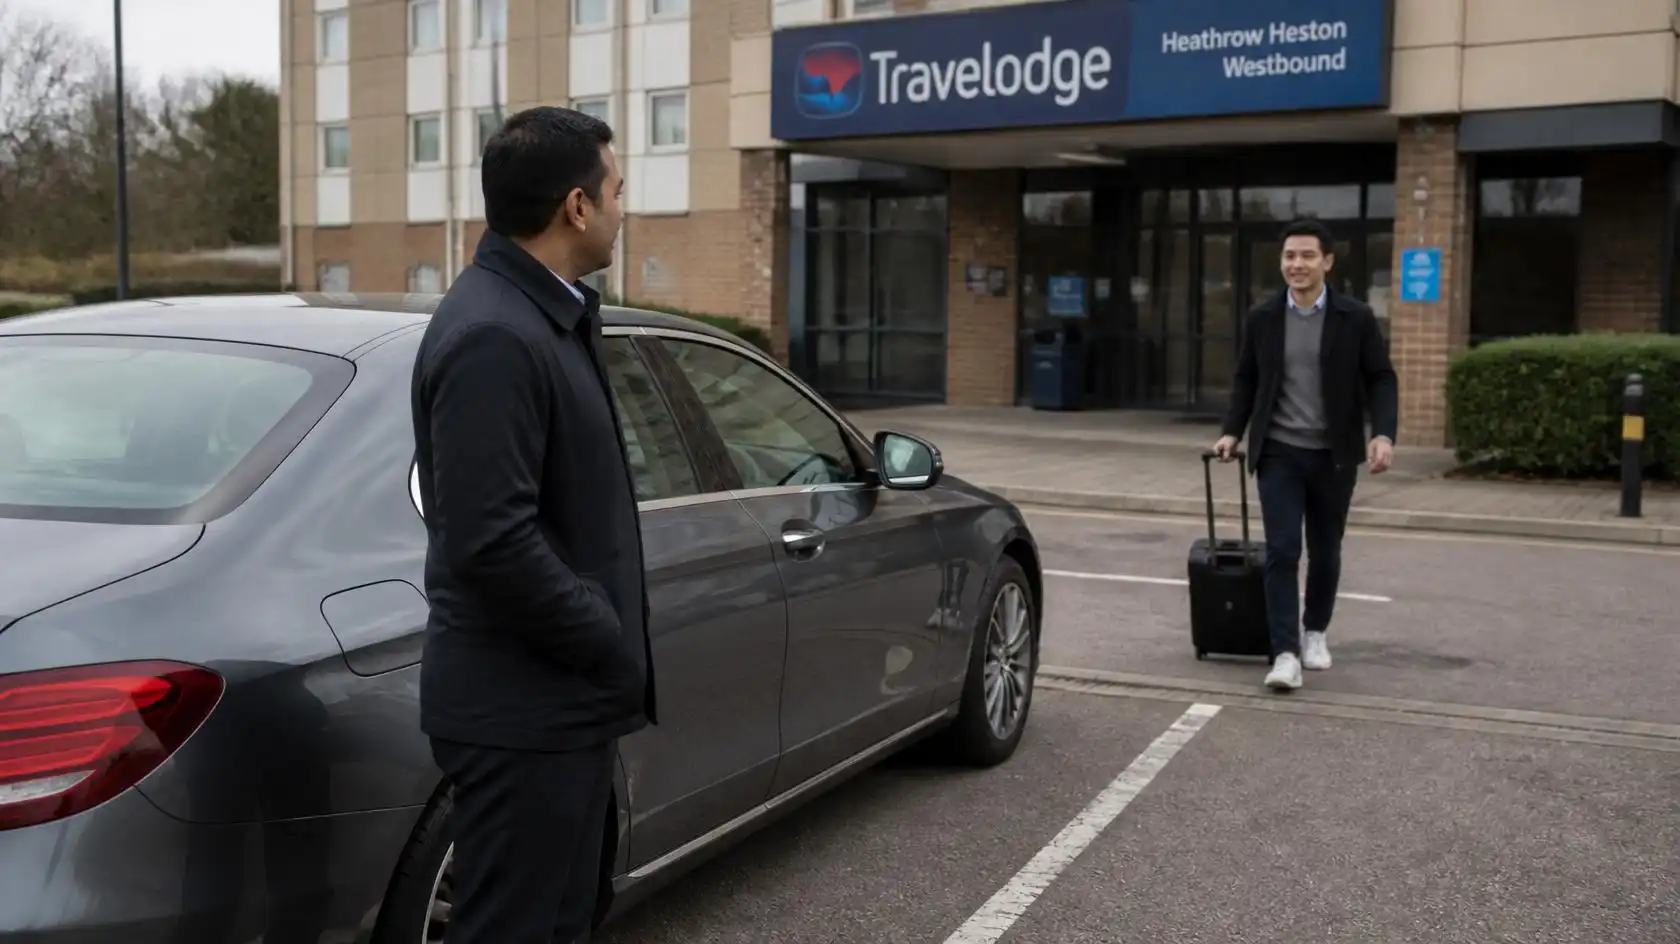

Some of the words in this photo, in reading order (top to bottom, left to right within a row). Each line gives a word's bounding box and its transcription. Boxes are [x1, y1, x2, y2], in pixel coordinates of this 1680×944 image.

[1162, 27, 1264, 53] Heathrow
[1269, 20, 1347, 44] Heston
[869, 36, 1112, 106] Travelodge
[1223, 47, 1346, 78] Westbound
